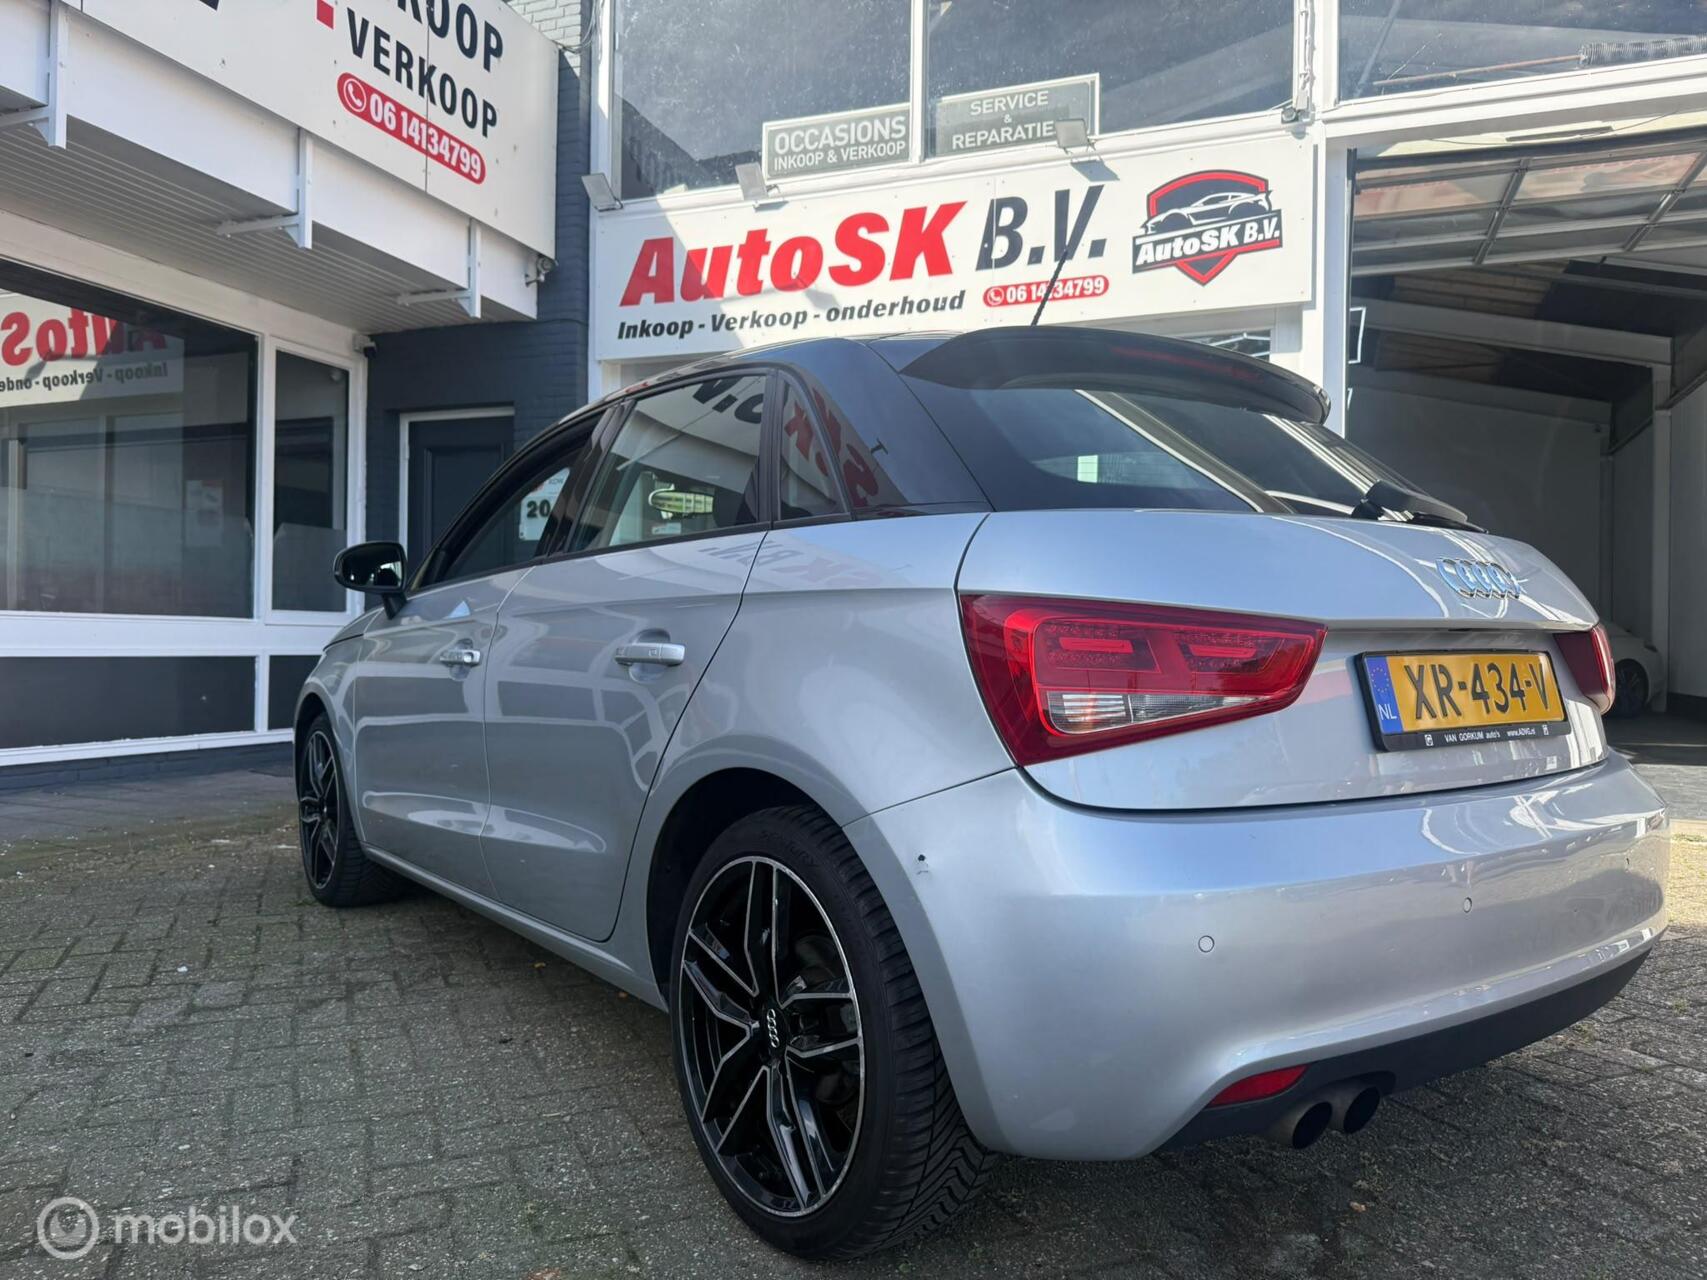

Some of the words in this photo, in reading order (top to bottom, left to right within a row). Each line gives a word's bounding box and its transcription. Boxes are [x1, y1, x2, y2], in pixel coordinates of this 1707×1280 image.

[347, 7, 497, 138] VERKOOP
[970, 90, 1049, 116] SERVICE
[1003, 113, 1012, 123] &
[369, 93, 396, 131] 06
[401, 111, 481, 180] 14134799
[774, 116, 906, 154] OCCASIONS
[952, 120, 1057, 149] REPARATIE
[774, 152, 824, 170] INKOOP
[827, 147, 837, 163] &
[840, 141, 905, 162] VERKOOP
[619, 201, 968, 307] AutoSK
[975, 184, 1107, 271] B.V.
[1136, 225, 1240, 265] AutoSK
[1243, 216, 1280, 243] B.V.
[1006, 286, 1027, 303] 06
[1030, 277, 1105, 301] 1434799
[617, 319, 693, 340] Inkoop
[711, 311, 808, 332] Verkoop
[826, 290, 966, 322] onderhoud
[527, 499, 551, 518] 20
[1404, 662, 1550, 720] XR-434-V
[1378, 704, 1397, 720] NL
[1444, 733, 1457, 743] VAN
[1458, 730, 1484, 742] GORKUM
